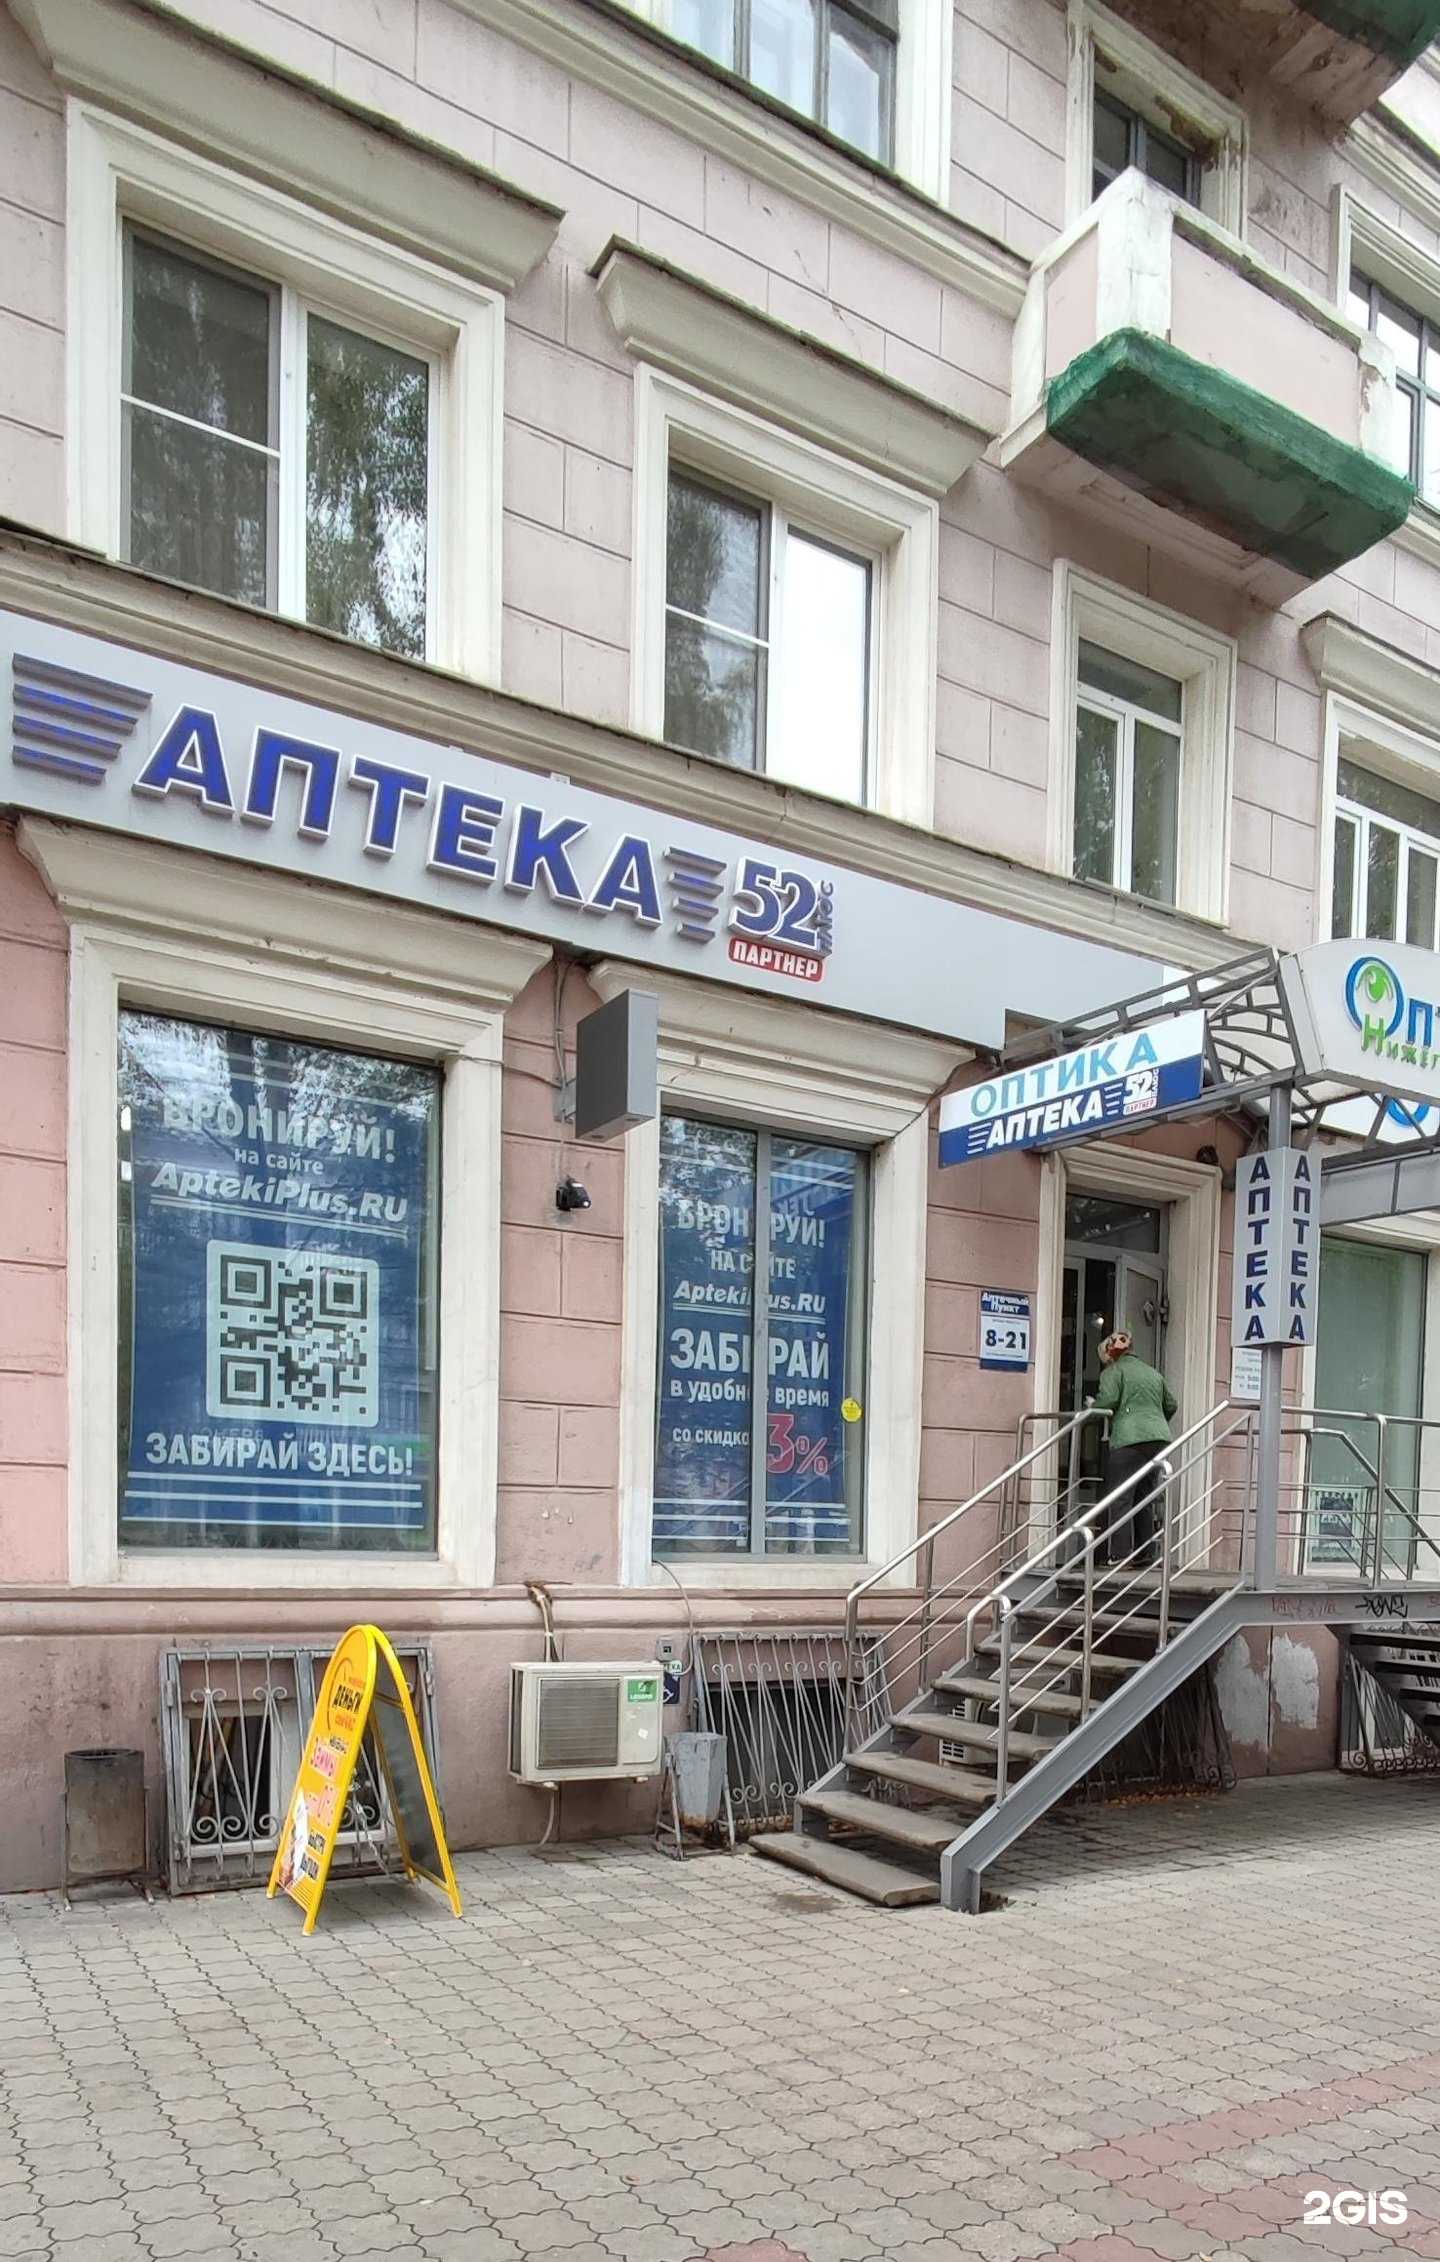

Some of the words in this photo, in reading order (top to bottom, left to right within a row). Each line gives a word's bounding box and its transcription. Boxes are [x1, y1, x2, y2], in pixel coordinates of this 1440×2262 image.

[132, 703, 663, 928] АПТЕКА
[728, 856, 819, 954] 52
[733, 940, 819, 978] ПАРТНЕР
[1345, 957, 1440, 1048] ОП
[971, 1032, 1158, 1117] ОПТИКА
[986, 1089, 1103, 1149] АПТЕКА
[1123, 1071, 1153, 1104] 52
[234, 1148, 260, 1165] на
[266, 1152, 324, 1175] сайте
[151, 1162, 408, 1222] AptekiPlus.RU
[677, 1198, 826, 1248] БРОНРУЙ!
[710, 1250, 736, 1272] НА
[1244, 1156, 1271, 1341] АПТЕКА
[1289, 1155, 1311, 1340] АПТЕКА
[673, 1280, 826, 1314] Aptekius.RU
[986, 1329, 1026, 1350] 8-21
[775, 1387, 829, 1410] время
[145, 1431, 298, 1471] ЗАБИРАЙ
[308, 1444, 413, 1478] ЗДЕСЬ!
[672, 1428, 691, 1442] со
[695, 1429, 751, 1447] скидко
